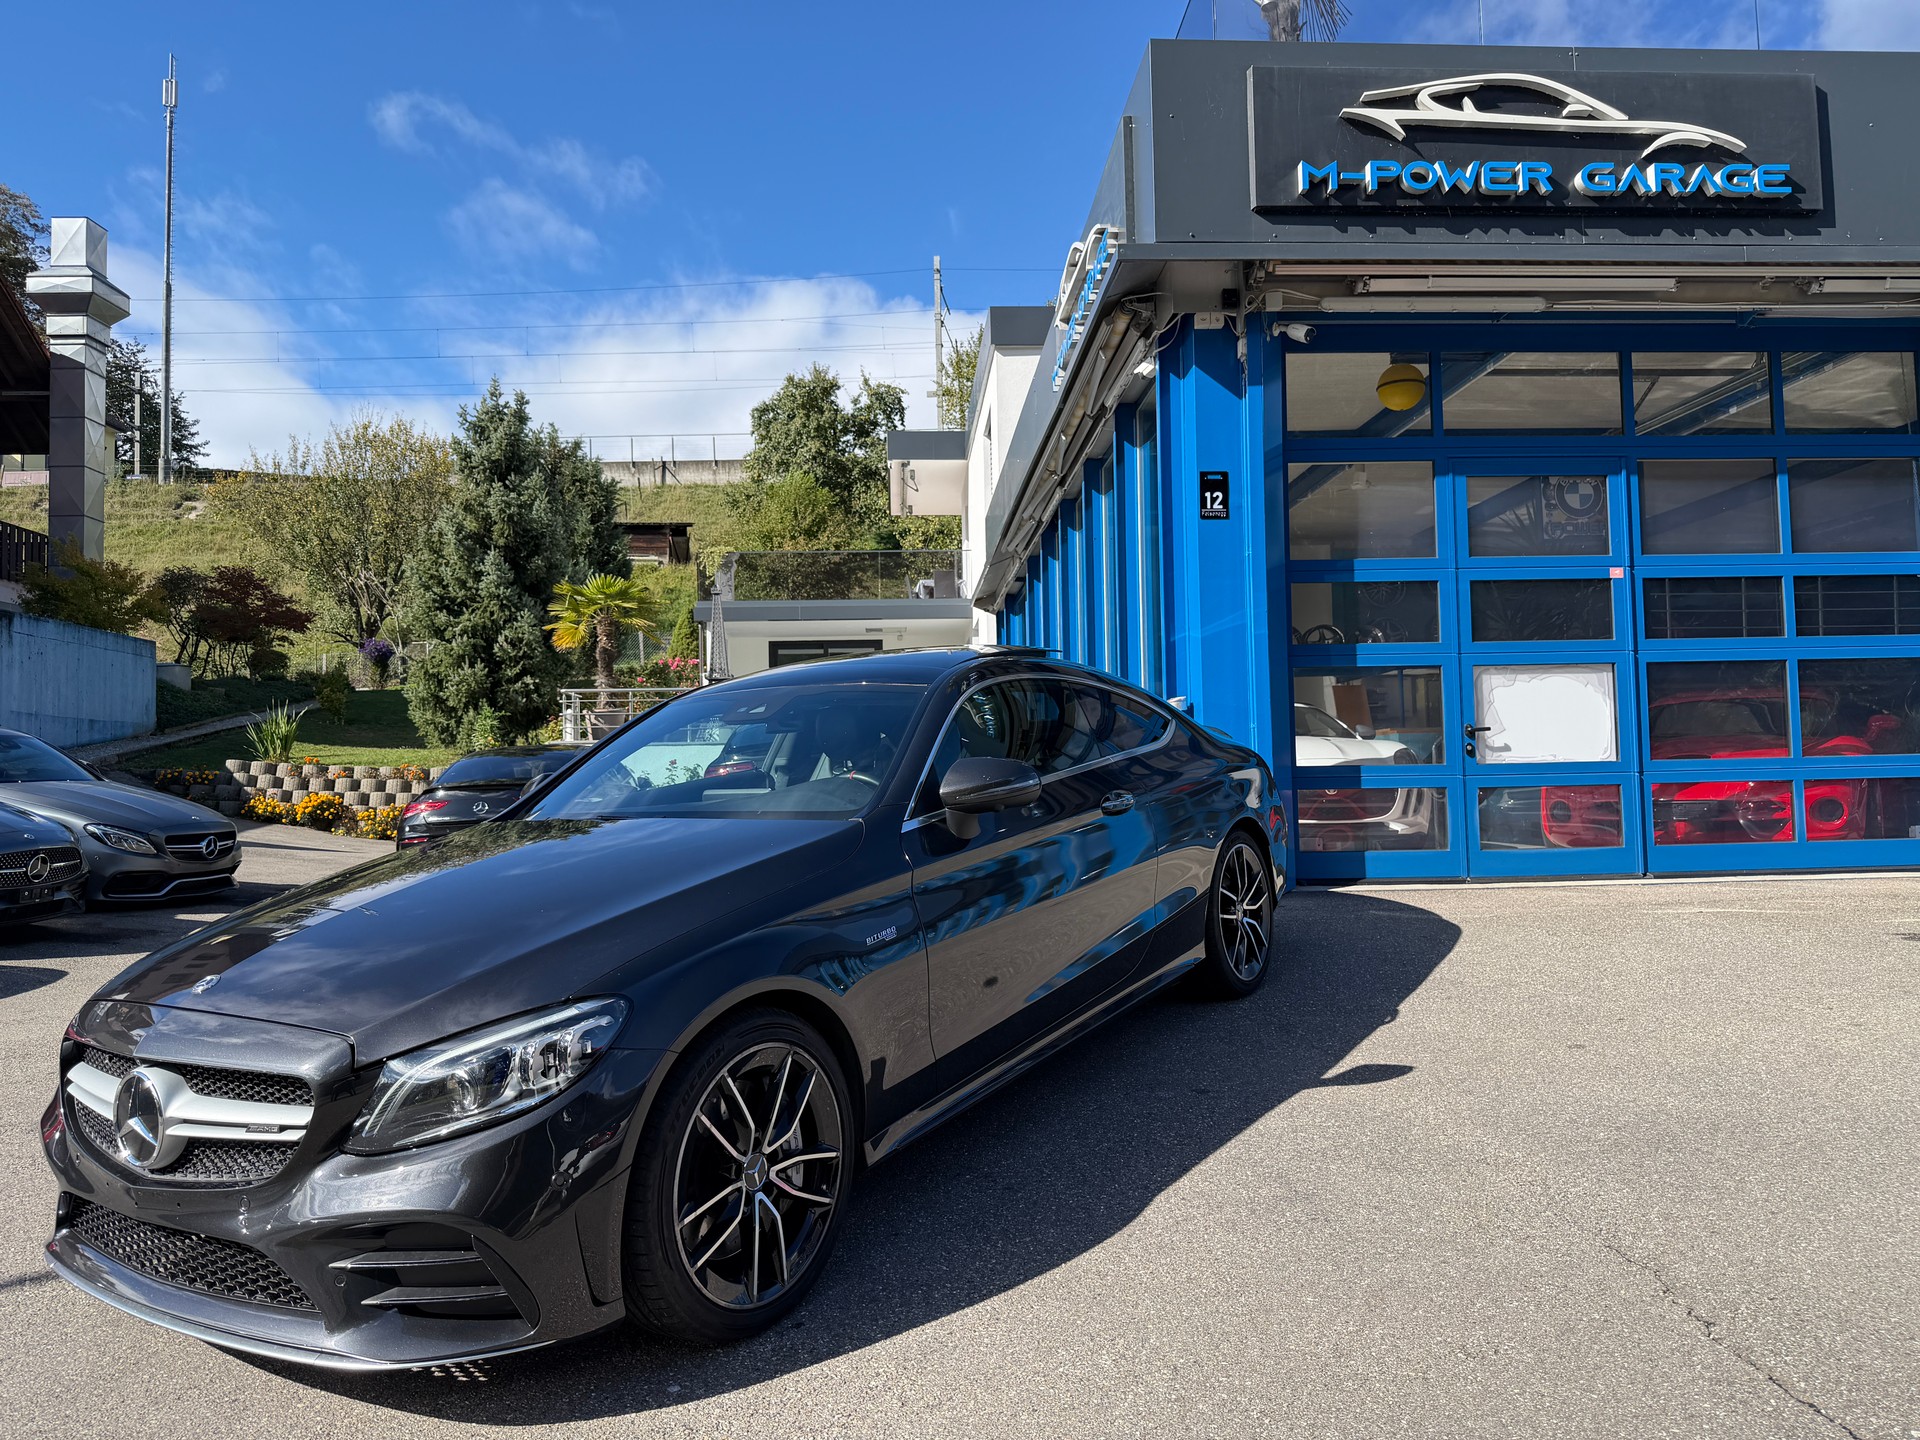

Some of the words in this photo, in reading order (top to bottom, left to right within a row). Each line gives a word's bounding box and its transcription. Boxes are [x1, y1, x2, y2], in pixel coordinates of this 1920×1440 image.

[1298, 160, 1553, 196] M-POWER
[1577, 162, 1793, 196] GARAGE
[1204, 491, 1224, 509] 12
[865, 925, 897, 944] BITURBO
